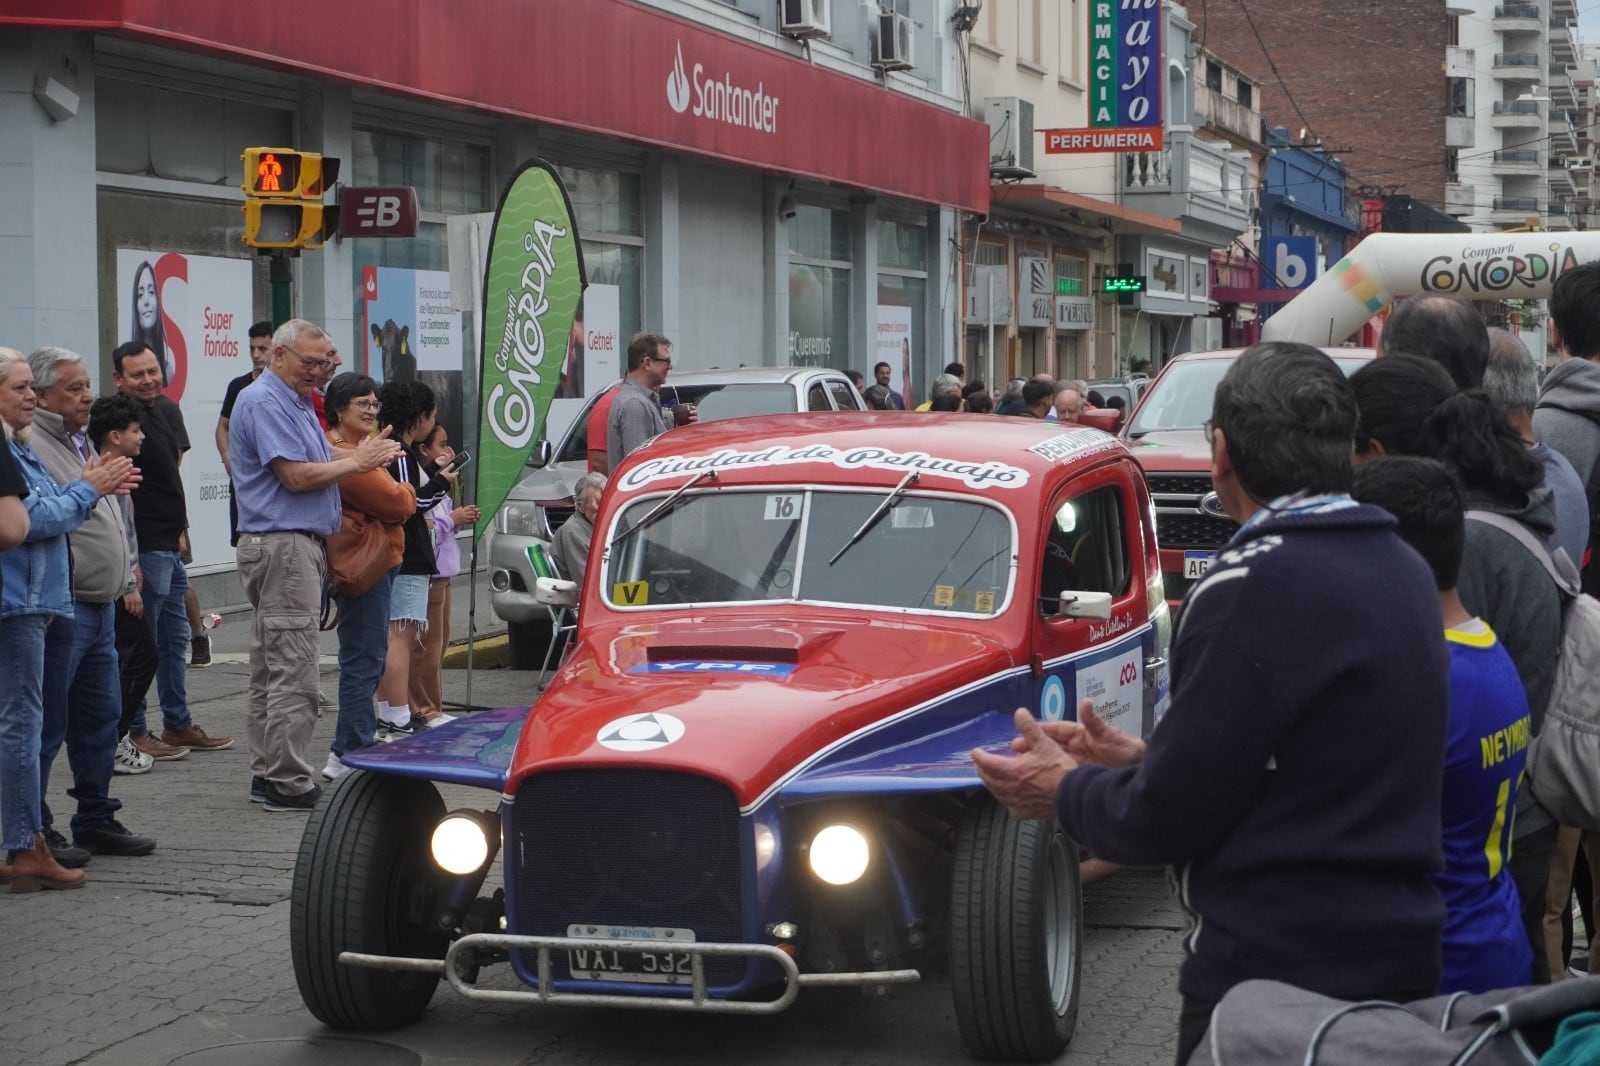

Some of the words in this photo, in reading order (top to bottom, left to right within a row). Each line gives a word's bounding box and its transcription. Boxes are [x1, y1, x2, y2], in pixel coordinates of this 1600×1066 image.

[693, 63, 779, 133] Santander
[1051, 133, 1154, 149] PERFUMERIA
[203, 306, 234, 337] Super
[204, 334, 239, 357] fondos
[588, 330, 614, 351] Getnet
[627, 449, 775, 485] Ciudad
[784, 445, 834, 460] de
[845, 449, 1017, 482] Pehuajó
[774, 496, 794, 518] 16
[623, 584, 640, 603] V
[654, 662, 777, 671] YPF
[1120, 662, 1136, 686] ACA
